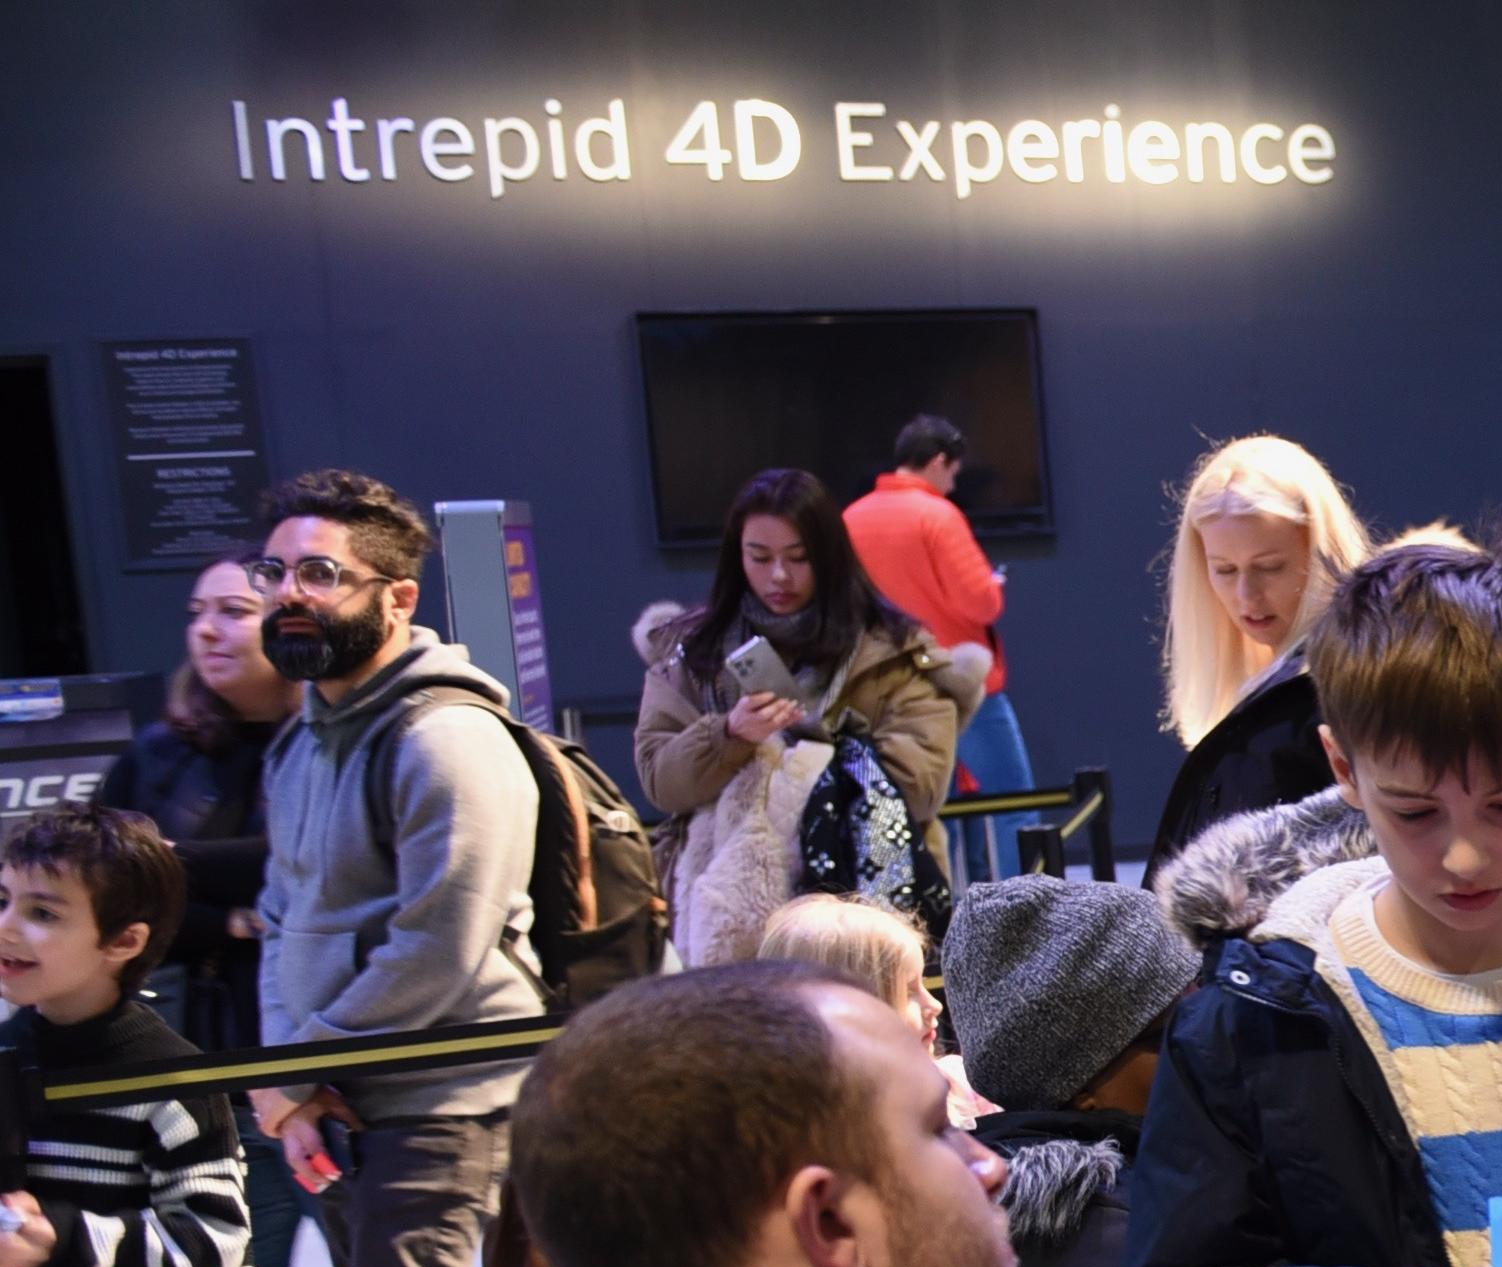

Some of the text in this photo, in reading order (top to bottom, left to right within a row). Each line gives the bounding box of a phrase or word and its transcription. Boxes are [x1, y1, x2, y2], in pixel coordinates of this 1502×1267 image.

[231, 97, 1337, 199] Intrepid 4D Experience
